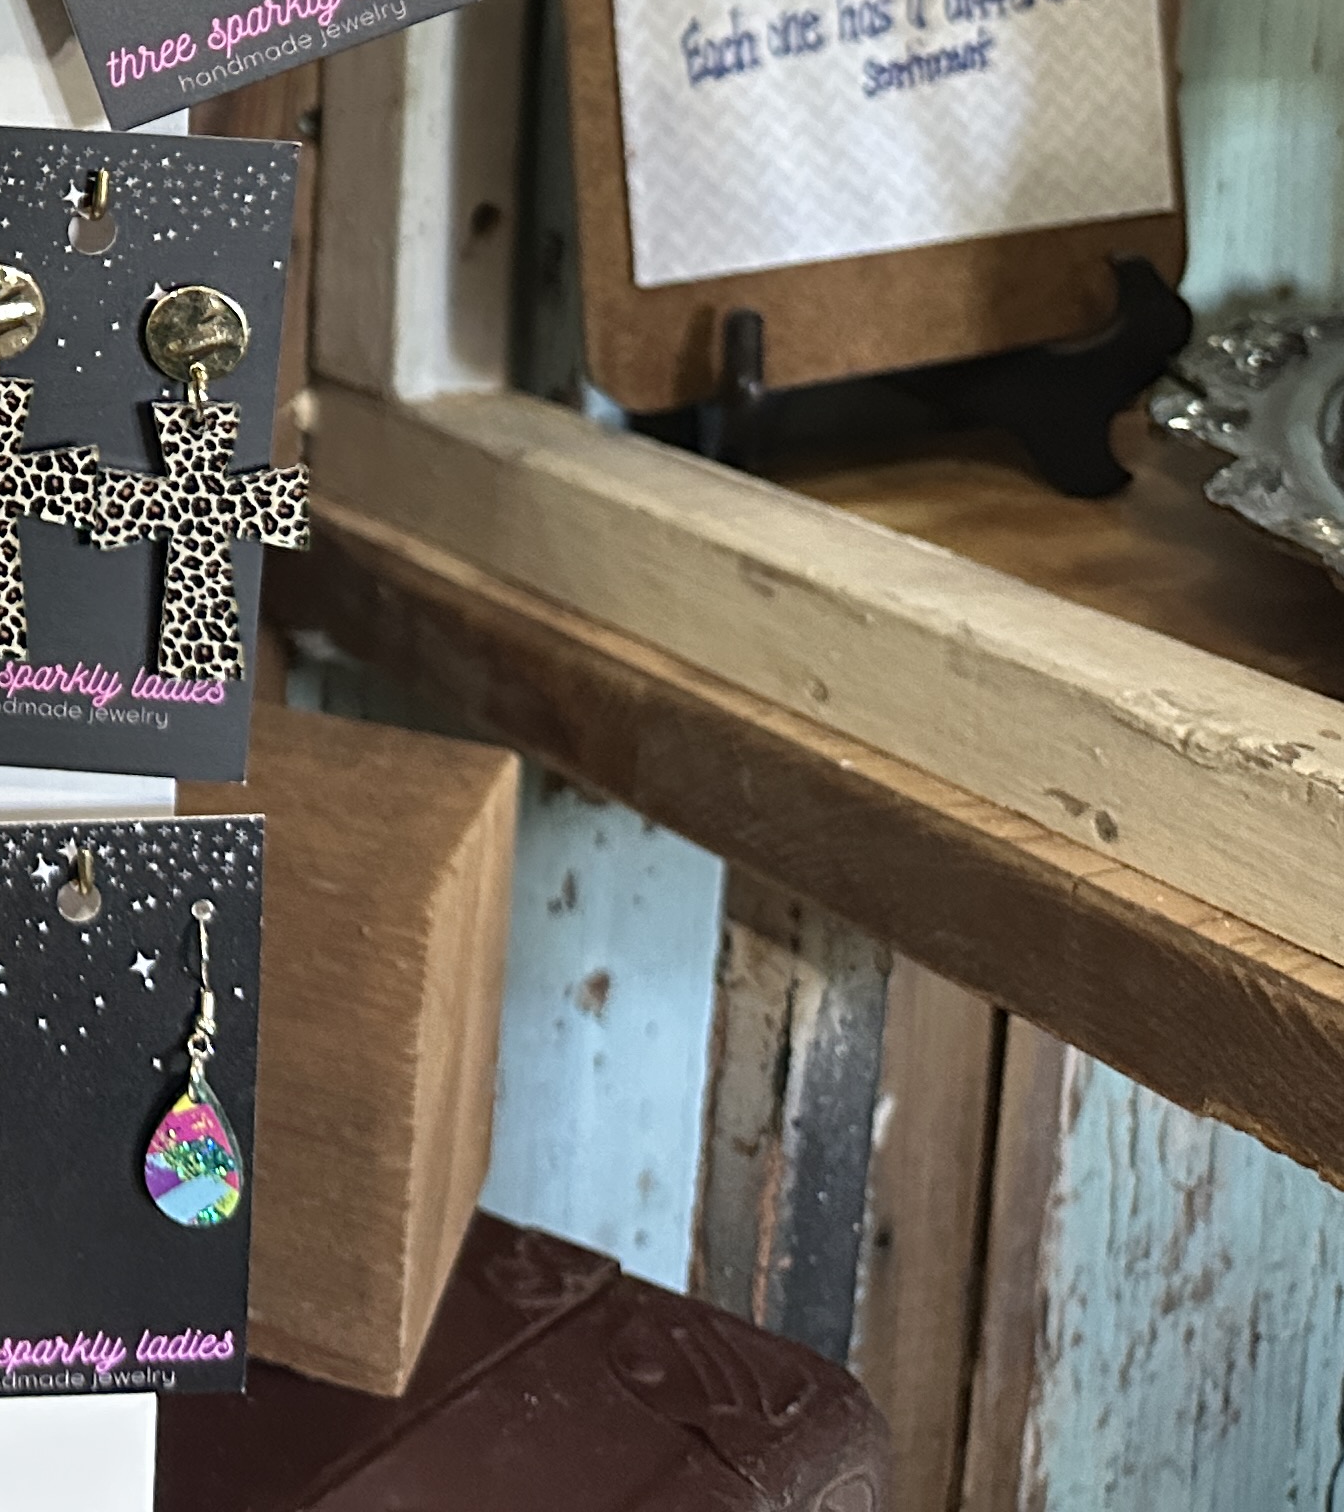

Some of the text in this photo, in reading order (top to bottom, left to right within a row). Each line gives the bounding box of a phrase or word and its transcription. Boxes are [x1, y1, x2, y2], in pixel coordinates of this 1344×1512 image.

[106, 32, 197, 88] three
[178, 30, 313, 92] handmade
[680, 6, 760, 88] Each
[767, 8, 827, 57] one
[87, 702, 169, 730] jewelry
[136, 1327, 234, 1364] ladies
[92, 1366, 176, 1391] jewelry
